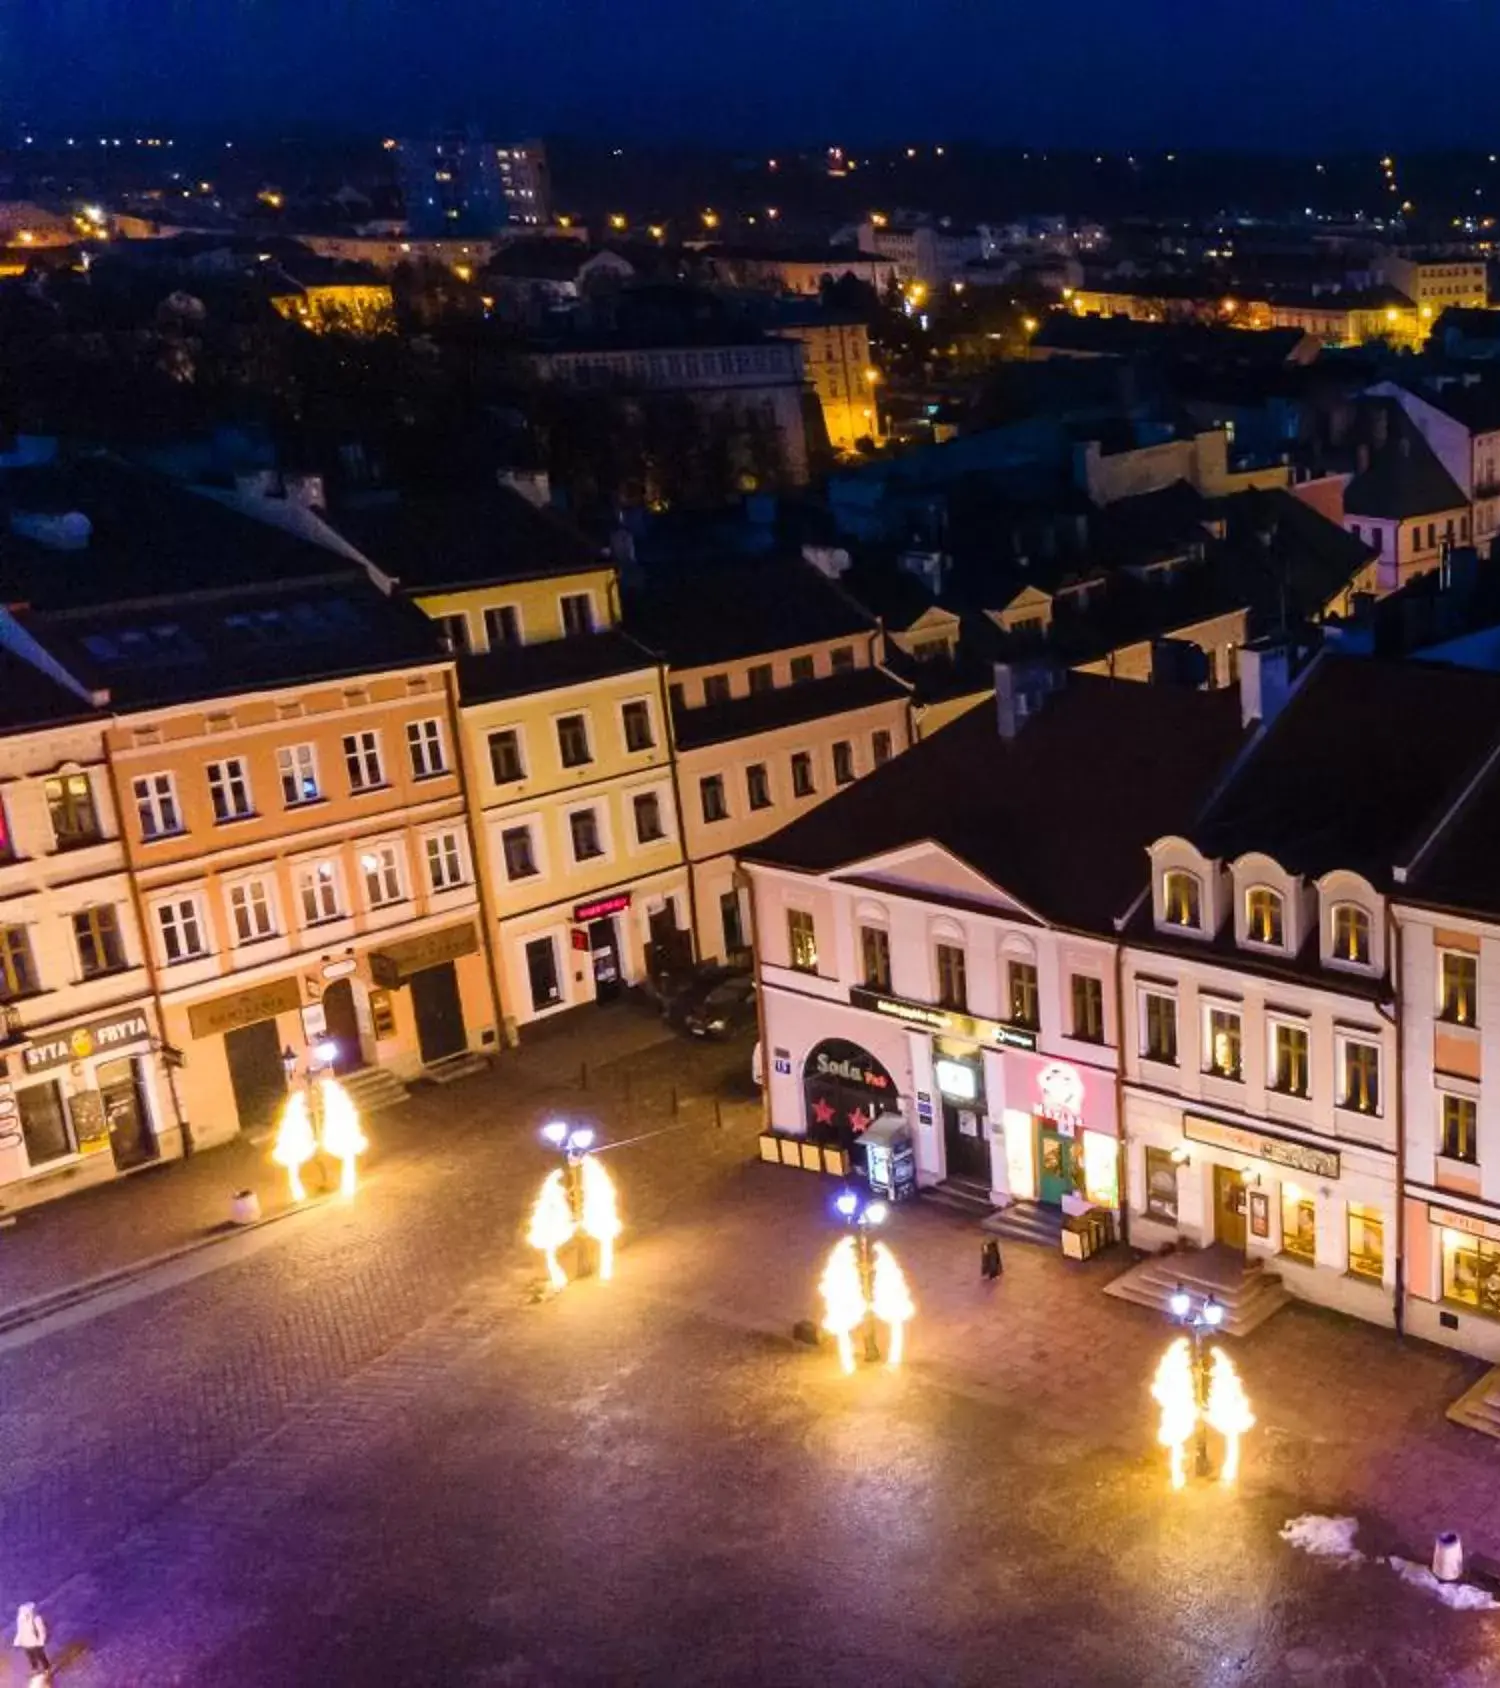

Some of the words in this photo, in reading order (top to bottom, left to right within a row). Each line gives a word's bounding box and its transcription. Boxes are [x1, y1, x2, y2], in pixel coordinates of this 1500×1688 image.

[26, 1040, 69, 1065] SYTA
[97, 1017, 147, 1045] FRYTA
[817, 1052, 863, 1081] Soda
